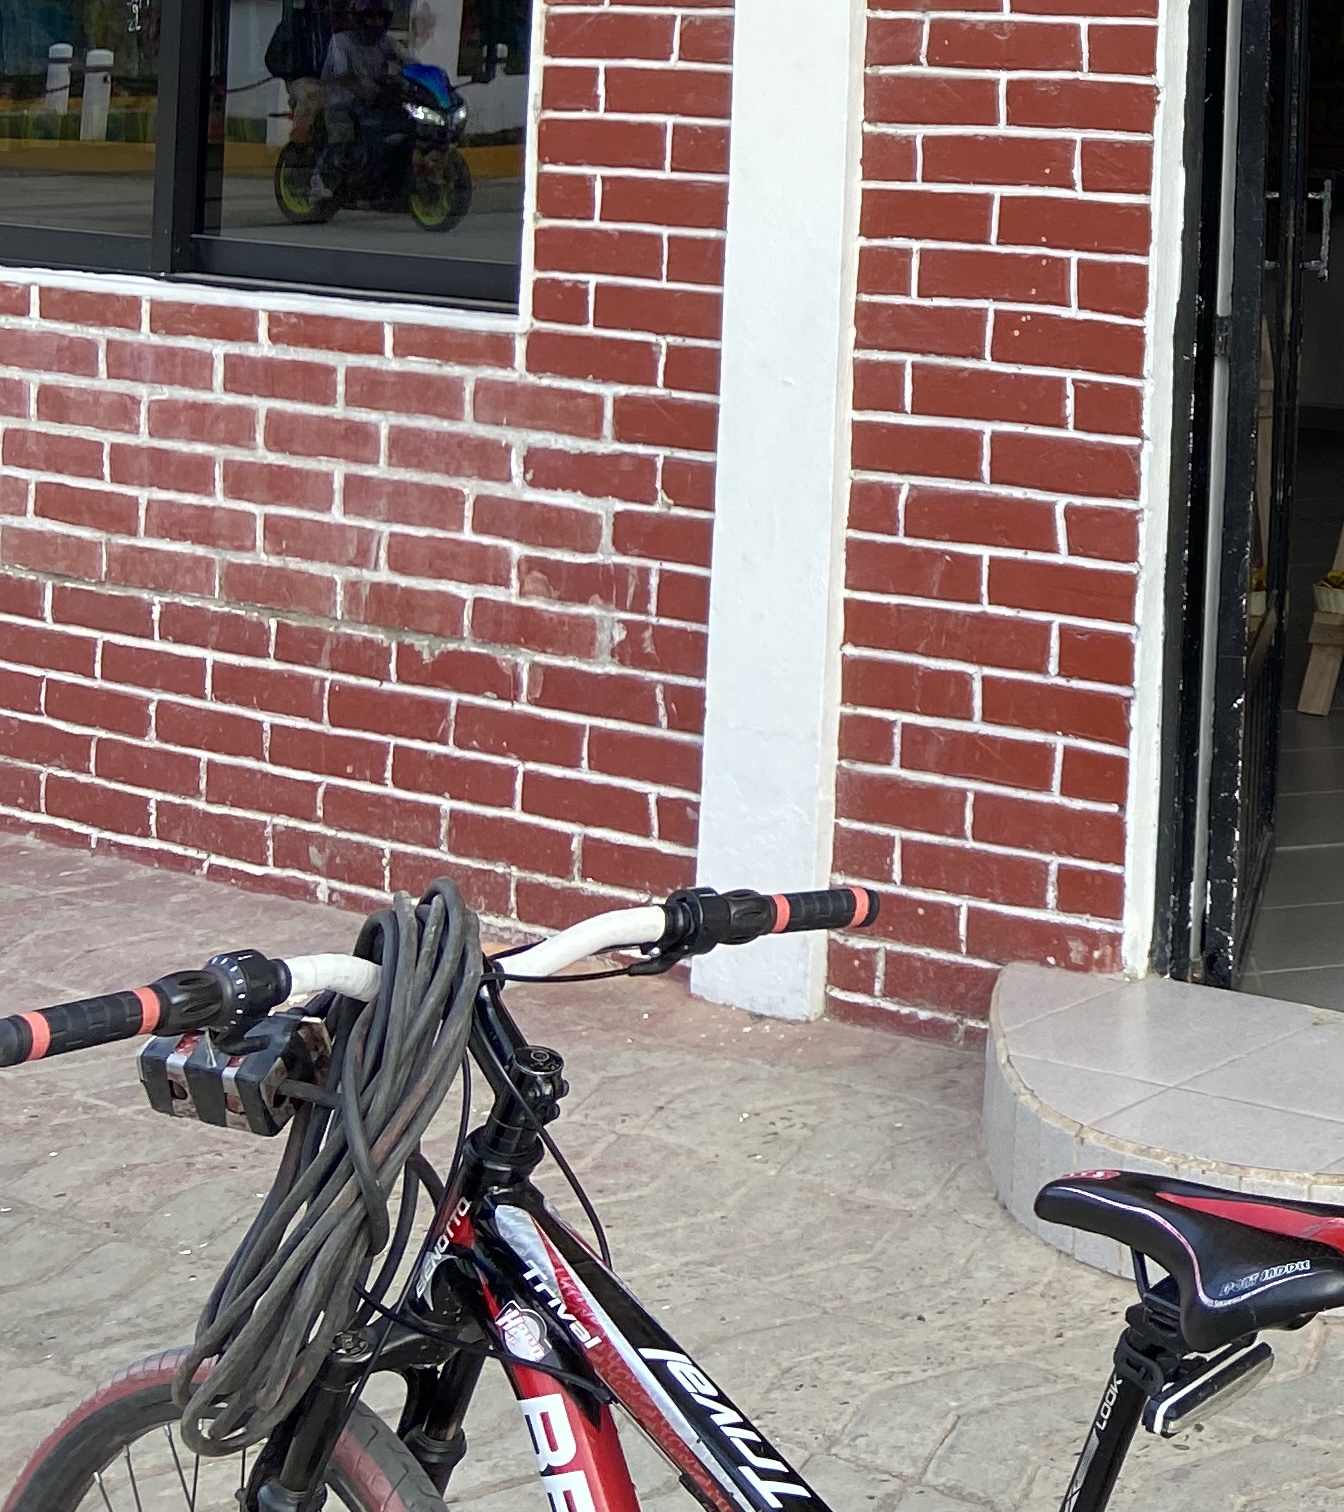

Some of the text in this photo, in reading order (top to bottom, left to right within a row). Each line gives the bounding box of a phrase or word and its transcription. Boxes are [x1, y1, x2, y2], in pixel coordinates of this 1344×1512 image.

[416, 1196, 473, 1299] BENOTTO
[523, 1259, 603, 1349] Trival
[637, 1347, 812, 1509] Trival
[1095, 1373, 1123, 1431] LOOK
